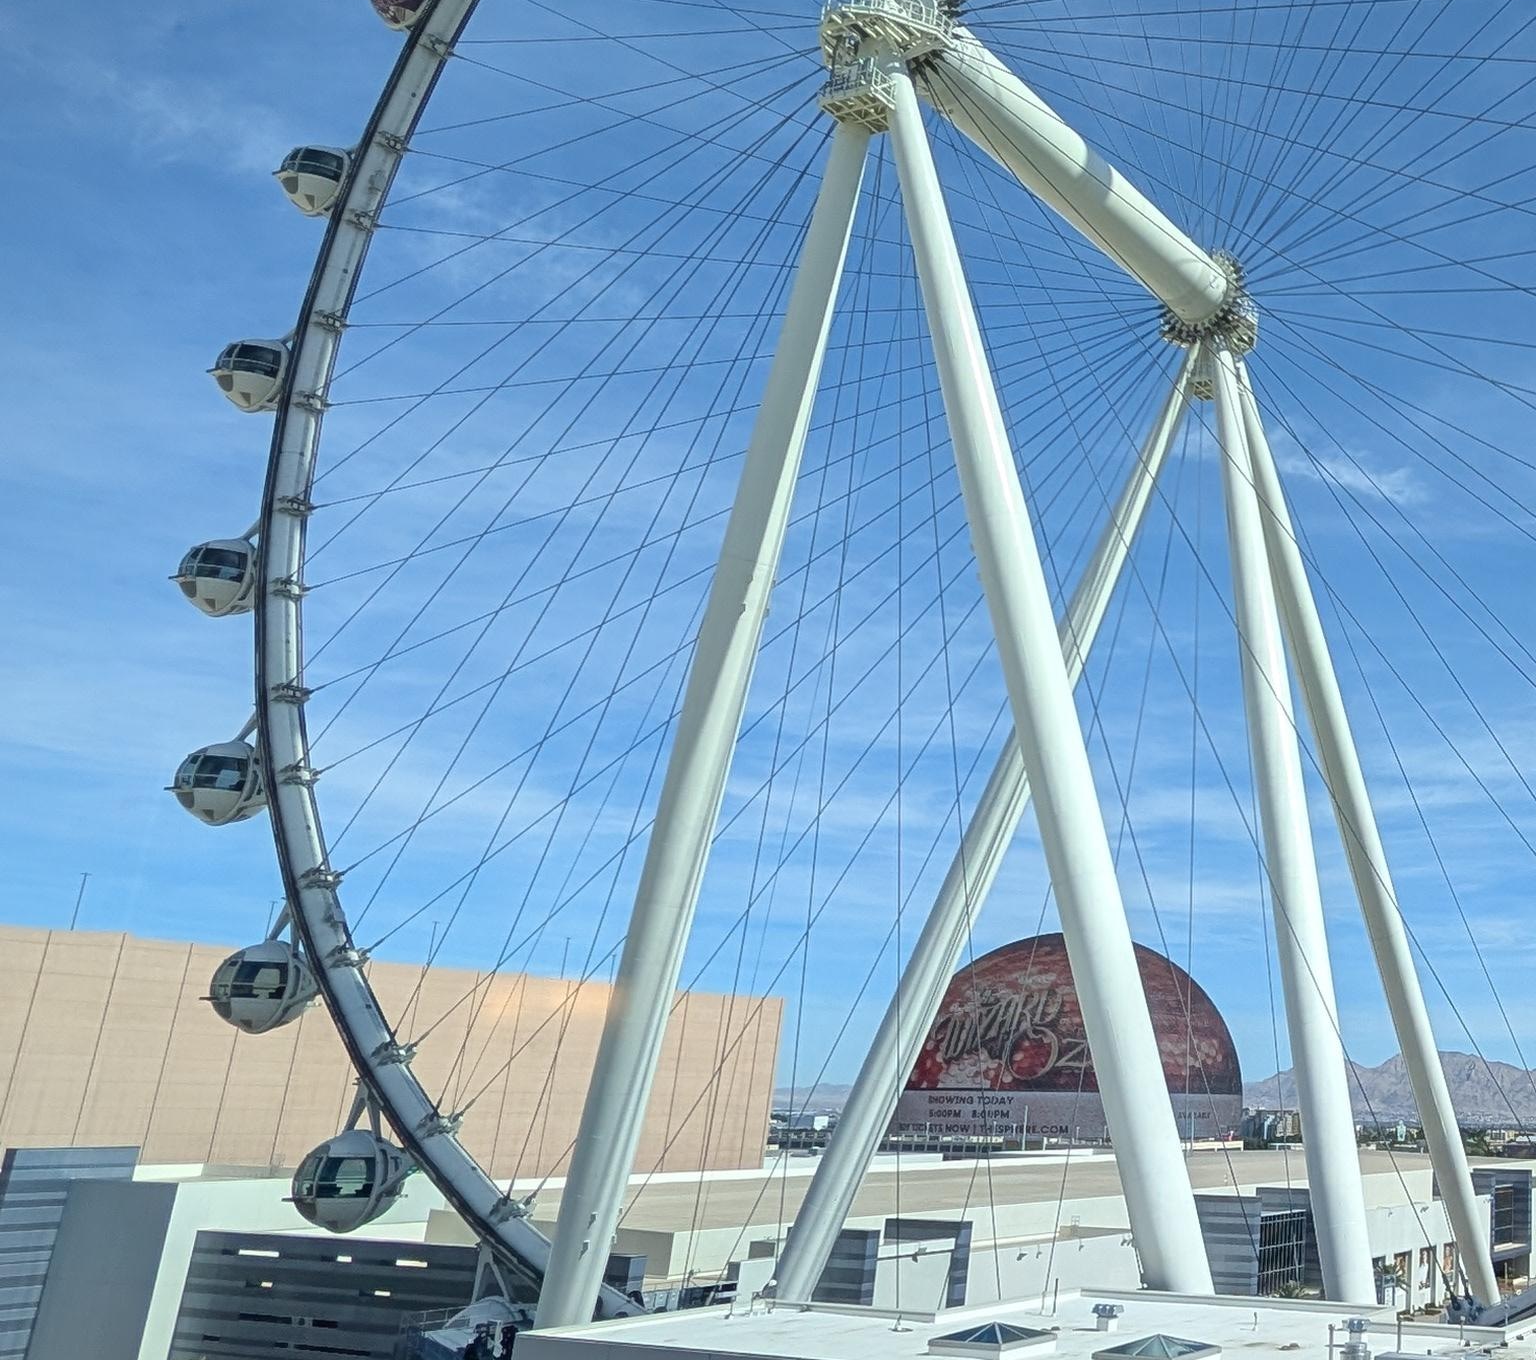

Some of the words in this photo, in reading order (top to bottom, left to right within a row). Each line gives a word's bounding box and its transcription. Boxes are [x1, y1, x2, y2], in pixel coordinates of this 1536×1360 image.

[932, 990, 1062, 1062] WIZARD
[928, 1095, 973, 1105] SHOWING
[977, 1095, 1014, 1105] TODAY
[928, 1109, 961, 1118] 5:00PM
[945, 1124, 970, 1133] NOW
